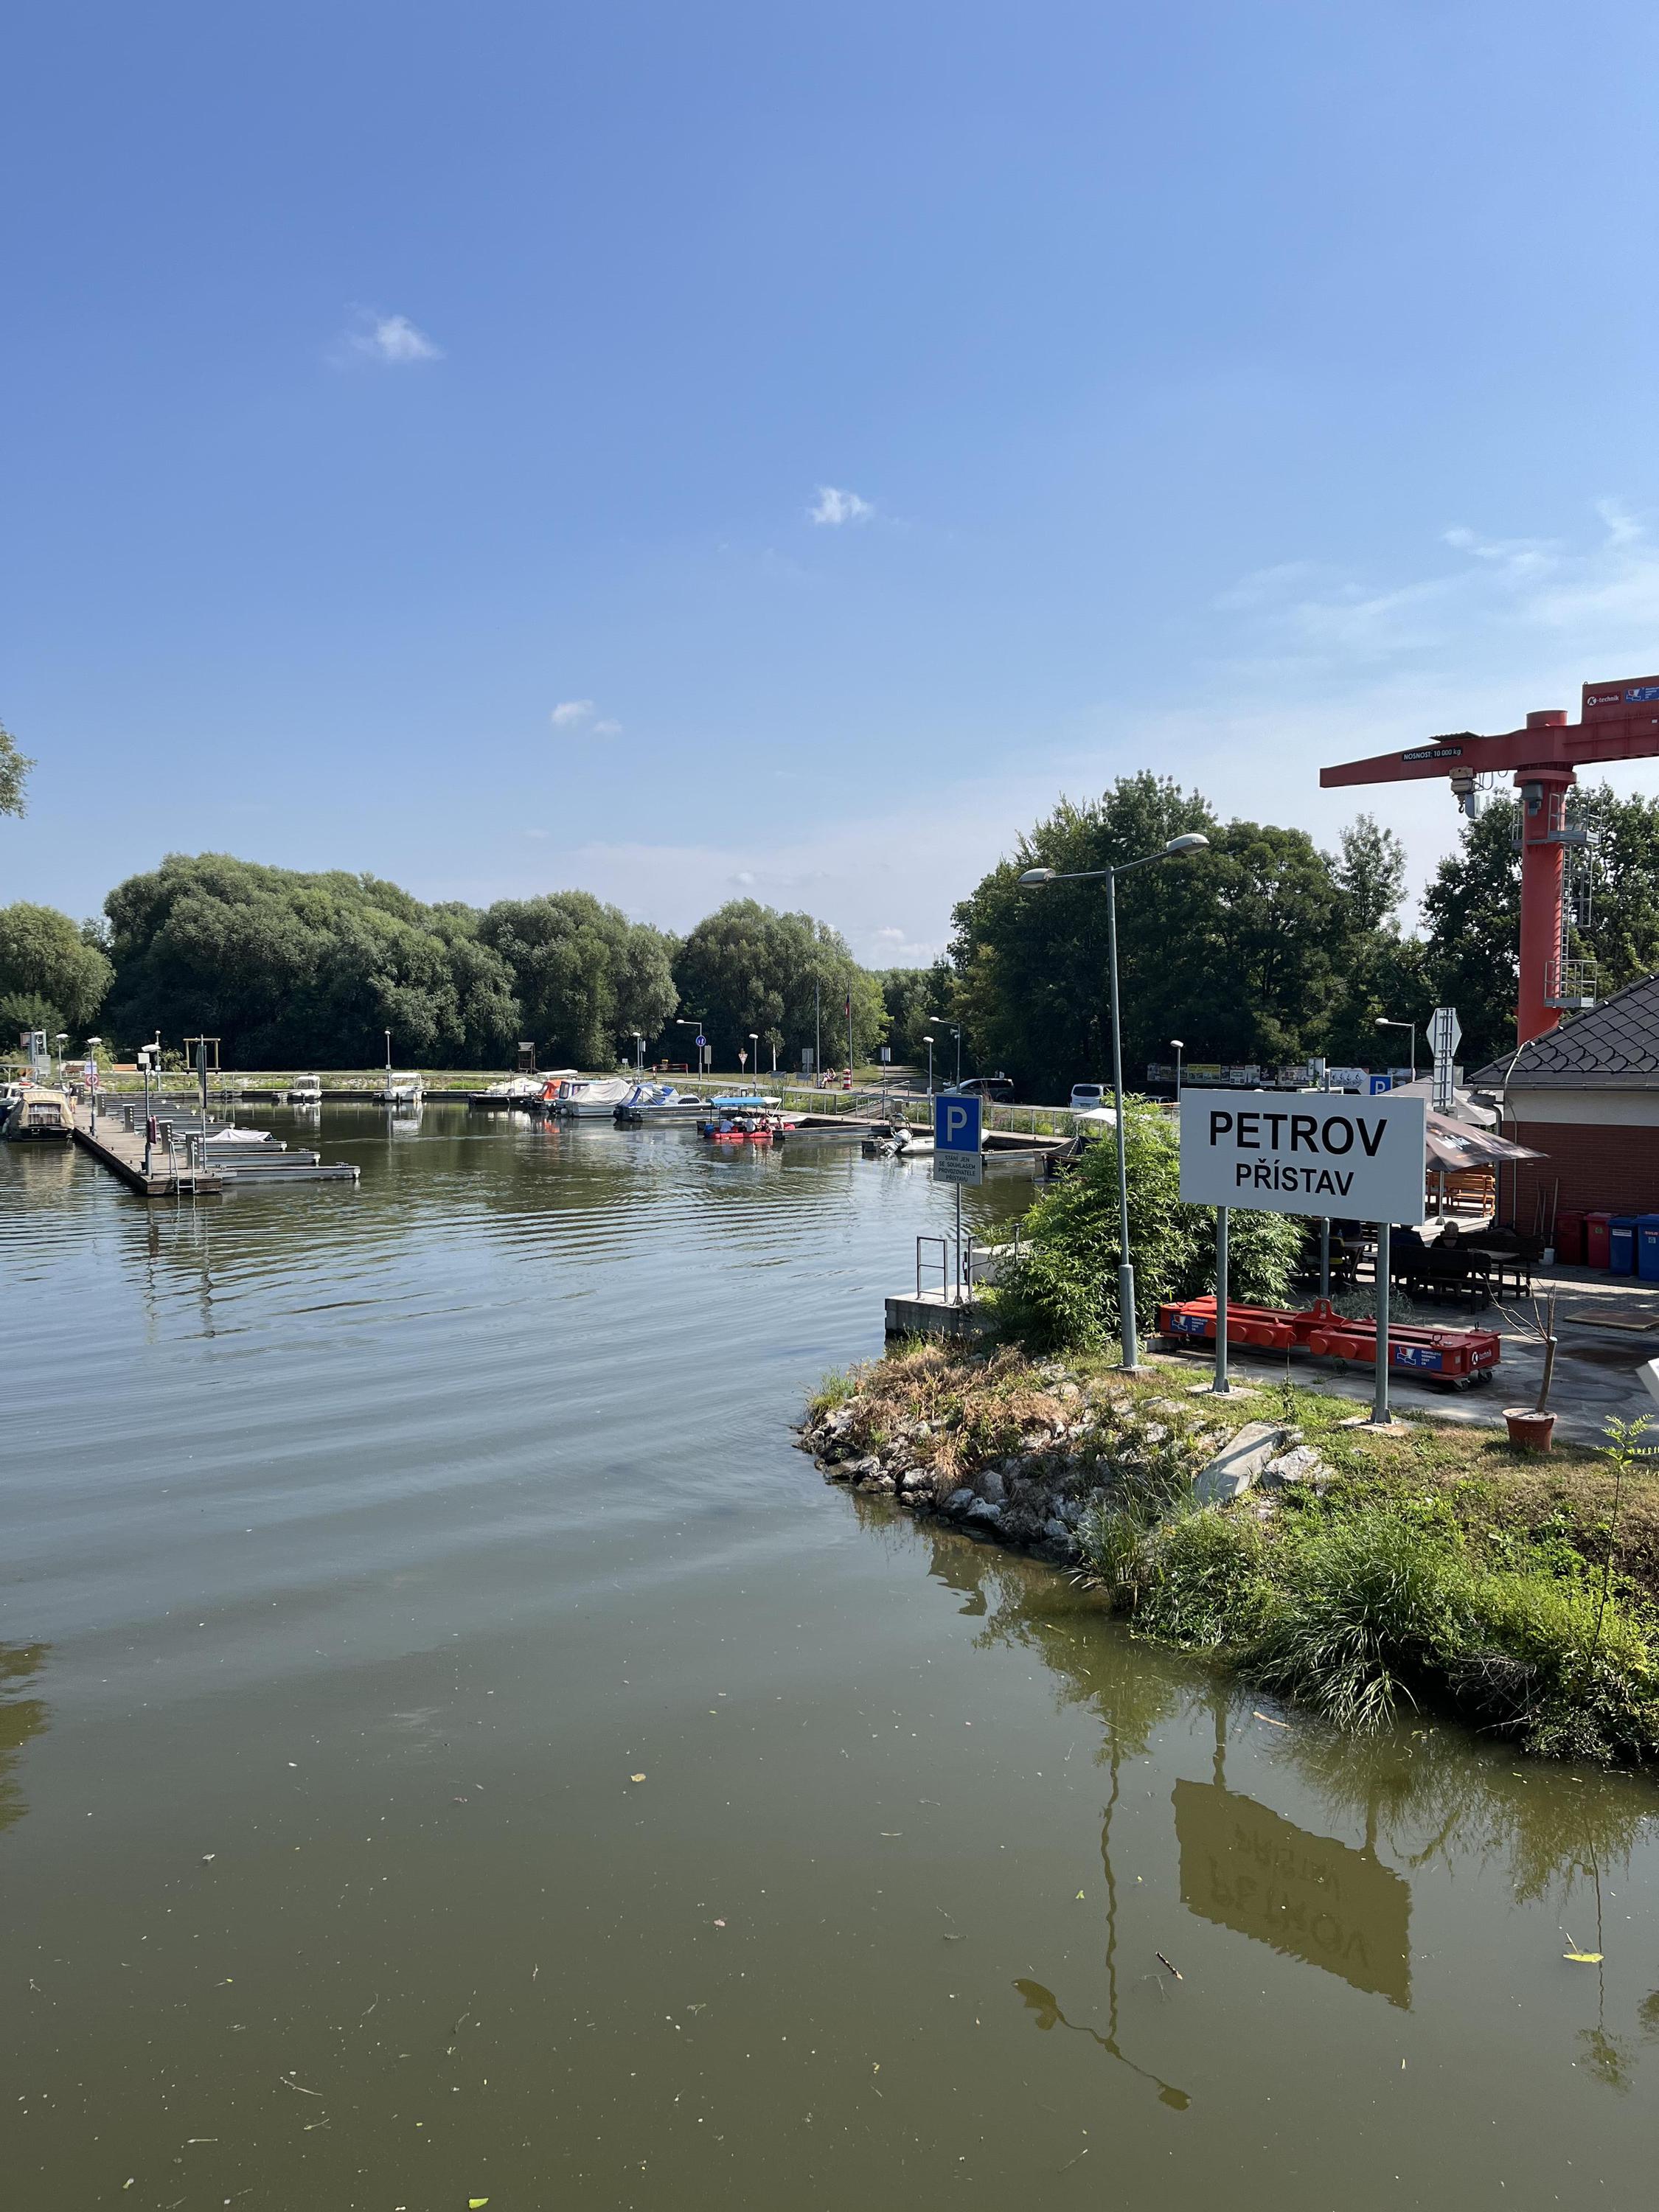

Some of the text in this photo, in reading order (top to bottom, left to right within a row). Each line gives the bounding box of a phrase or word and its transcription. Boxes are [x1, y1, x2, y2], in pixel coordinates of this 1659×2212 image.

[1587, 695, 1619, 706] K-technik
[947, 1105, 967, 1141] P
[1210, 1110, 1388, 1157] PETROV
[938, 1167, 975, 1176] PROVOZOVATELE
[947, 1161, 975, 1169] SOUHLASEM
[1236, 1158, 1354, 1196] PŘÍSTAV
